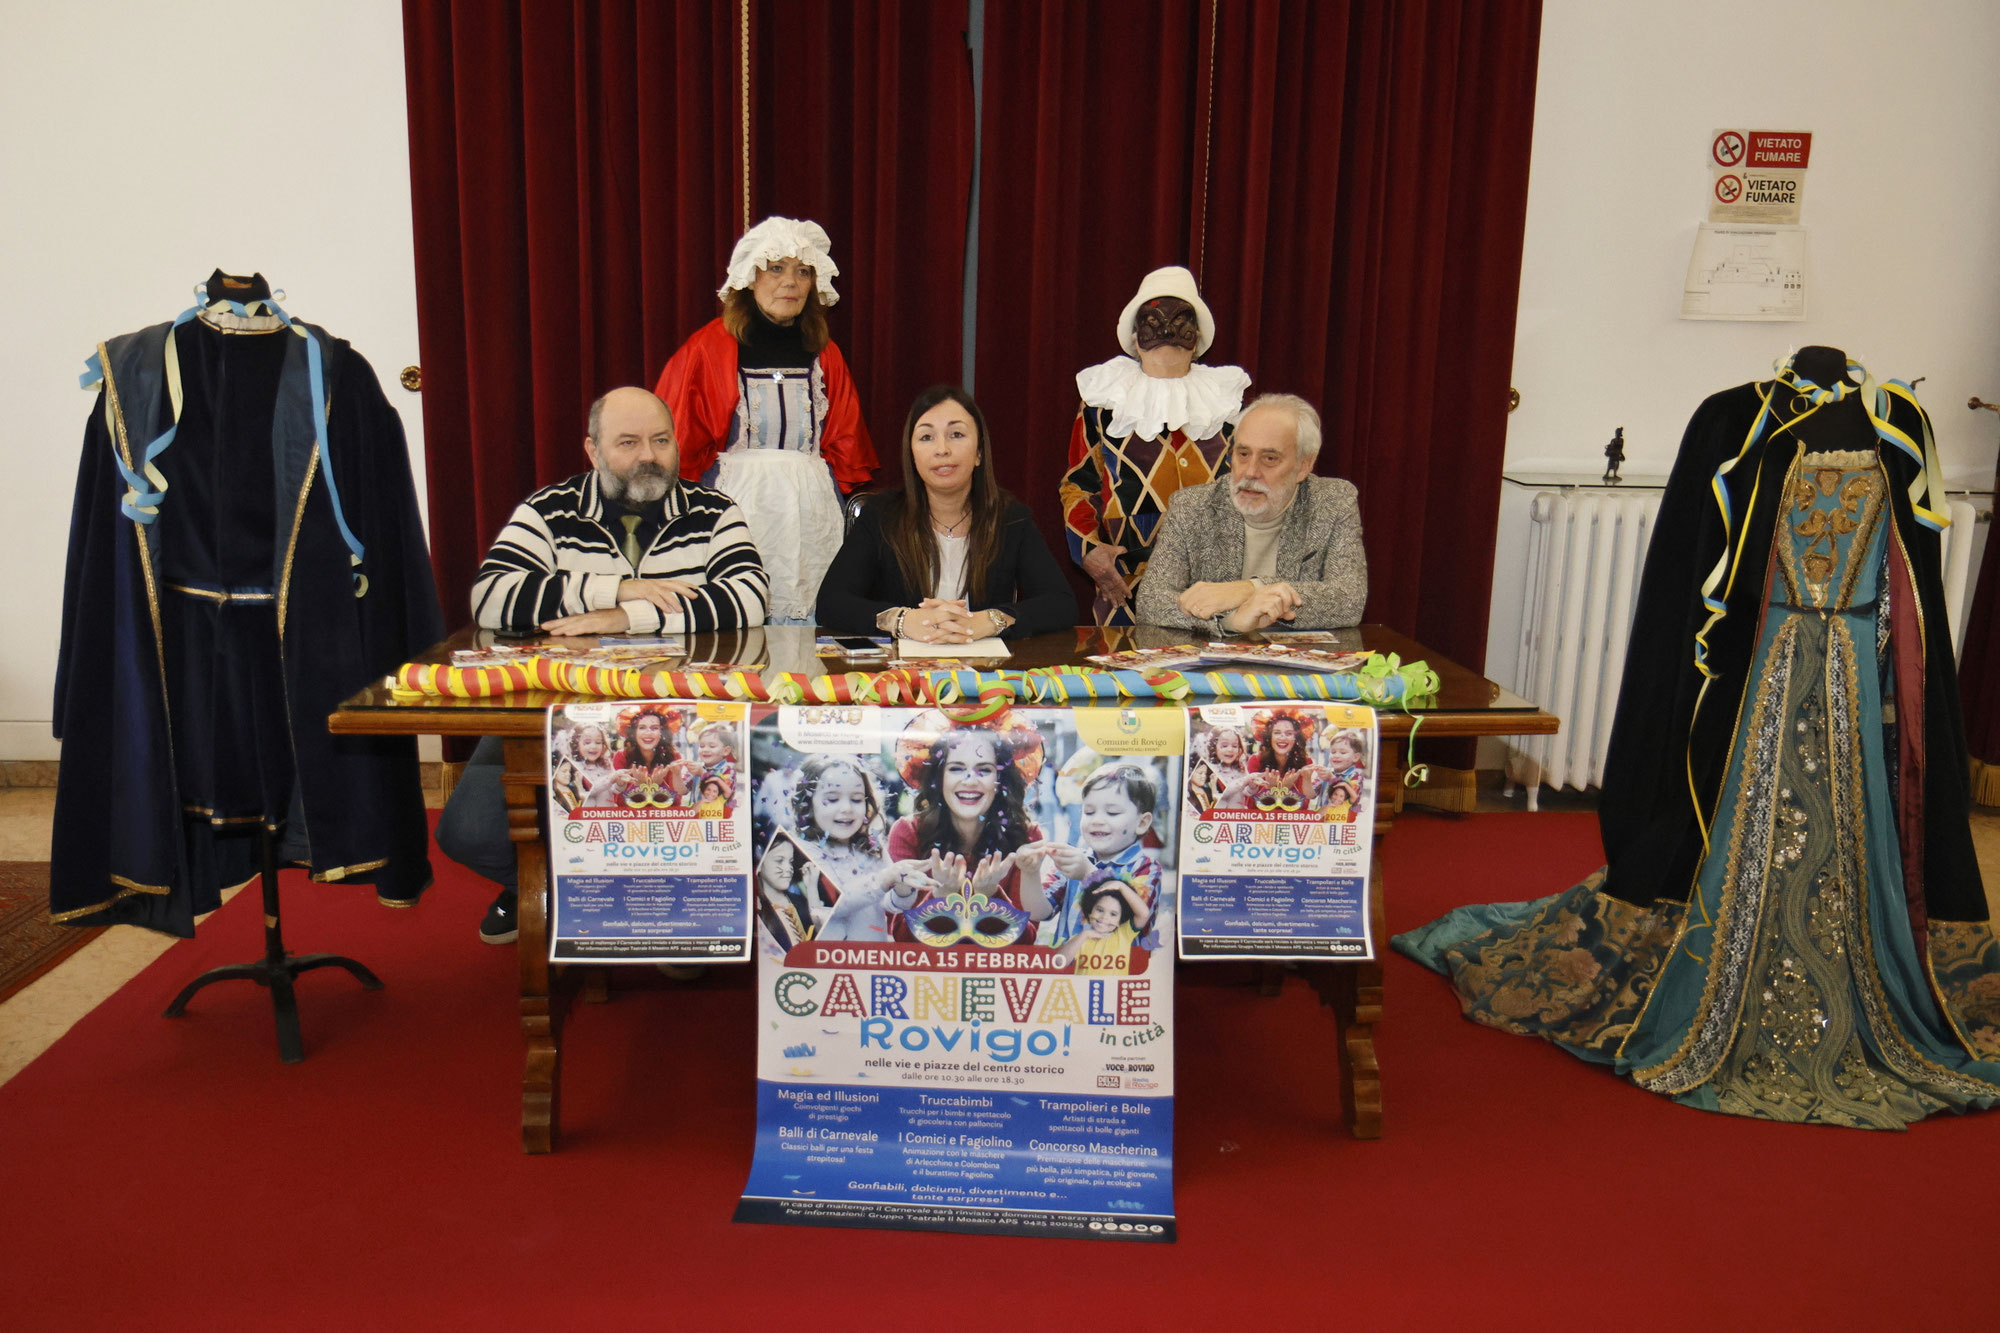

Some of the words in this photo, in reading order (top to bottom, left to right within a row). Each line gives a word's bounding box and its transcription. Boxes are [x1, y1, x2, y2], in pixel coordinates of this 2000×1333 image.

[1757, 138, 1801, 148] VIETATO
[1755, 152, 1801, 162] FUMARE
[1748, 180, 1796, 191] VIETATO
[1746, 192, 1795, 203] FUMARE
[1097, 738, 1129, 746] Comune
[1131, 737, 1139, 745] di
[1141, 738, 1167, 747] Rovigo
[582, 810, 634, 818] DOMENICA
[1213, 812, 1263, 820] DOMENICA
[1277, 813, 1321, 821] FEBBRAIO
[564, 821, 734, 843] CARNEVALE
[1194, 823, 1356, 845] CARNEVALE
[604, 842, 698, 861] Rovigo!
[721, 841, 742, 852] città
[1343, 845, 1362, 855] città
[1230, 843, 1321, 863] Rovigo!
[816, 949, 931, 967] DOMENICA
[937, 952, 958, 967] 15
[965, 952, 1066, 969] FEBBRAIO
[1079, 955, 1126, 970] 2026
[774, 972, 1150, 1025] CARNEVALE
[860, 1017, 1071, 1062] Rovigo!
[1100, 1028, 1116, 1046] in
[1123, 1022, 1165, 1047] città
[865, 1058, 892, 1068] nelle
[895, 1060, 911, 1069] vie
[924, 1061, 959, 1071] piazze
[963, 1062, 980, 1072] del
[984, 1064, 1025, 1073] centro
[1029, 1065, 1064, 1074] storico
[942, 1075, 965, 1083] 10.30
[778, 1089, 813, 1102] Magia
[817, 1091, 831, 1101] ed
[835, 1091, 879, 1102] Illusioni
[920, 1095, 993, 1107] Truccabimbi
[793, 1103, 838, 1112] Coinvolgenti
[840, 1105, 861, 1113] giochi
[1040, 1100, 1107, 1113] Trampolieri
[1122, 1104, 1151, 1114] Bolle
[817, 1114, 848, 1122] prestigio
[900, 1107, 925, 1115] Trucchi
[945, 1109, 965, 1117] bimbi
[973, 1111, 1011, 1119] spettacolo
[917, 1118, 952, 1126] giocoleria
[1096, 1116, 1119, 1124] strada
[779, 1126, 803, 1138] Balli
[807, 1128, 817, 1139] di
[821, 1128, 878, 1141] Carnevale
[1049, 1125, 1084, 1133] spettacoli
[1095, 1126, 1112, 1134] bolle
[1114, 1127, 1139, 1136] giganti
[899, 1132, 902, 1142] I
[906, 1132, 946, 1144] Comici
[950, 1136, 956, 1145] e
[960, 1135, 1012, 1149] Fagiolino
[781, 1143, 808, 1151] Classici
[810, 1143, 825, 1151] balli
[855, 1146, 874, 1154] festa
[903, 1147, 944, 1156] Animazione
[970, 1151, 1005, 1159] maschere
[1030, 1140, 1085, 1152] Concorso
[1090, 1143, 1158, 1156] Mascherina
[807, 1155, 845, 1163] strepitosa!
[915, 1159, 953, 1167] Arlecchino
[961, 1160, 1000, 1169] Colombina
[926, 1169, 959, 1177] burattino
[961, 1170, 993, 1179] Fagiolino
[1040, 1166, 1059, 1174] bella,
[1061, 1167, 1072, 1175] più
[1074, 1168, 1112, 1177] simpatica,
[1114, 1170, 1125, 1178] più
[1127, 1171, 1157, 1179] giovane,
[848, 1181, 908, 1192] Gonfiabili,
[911, 1184, 965, 1194] dolciumi,
[969, 1187, 1046, 1197] divertimento
[1107, 1179, 1141, 1188] ecologica
[947, 1195, 1004, 1204] sorprese!
[804, 1209, 866, 1217] informazioni:
[826, 1202, 874, 1211] maltempo
[884, 1206, 930, 1214] Carnevale
[1001, 1211, 1047, 1219] domenica
